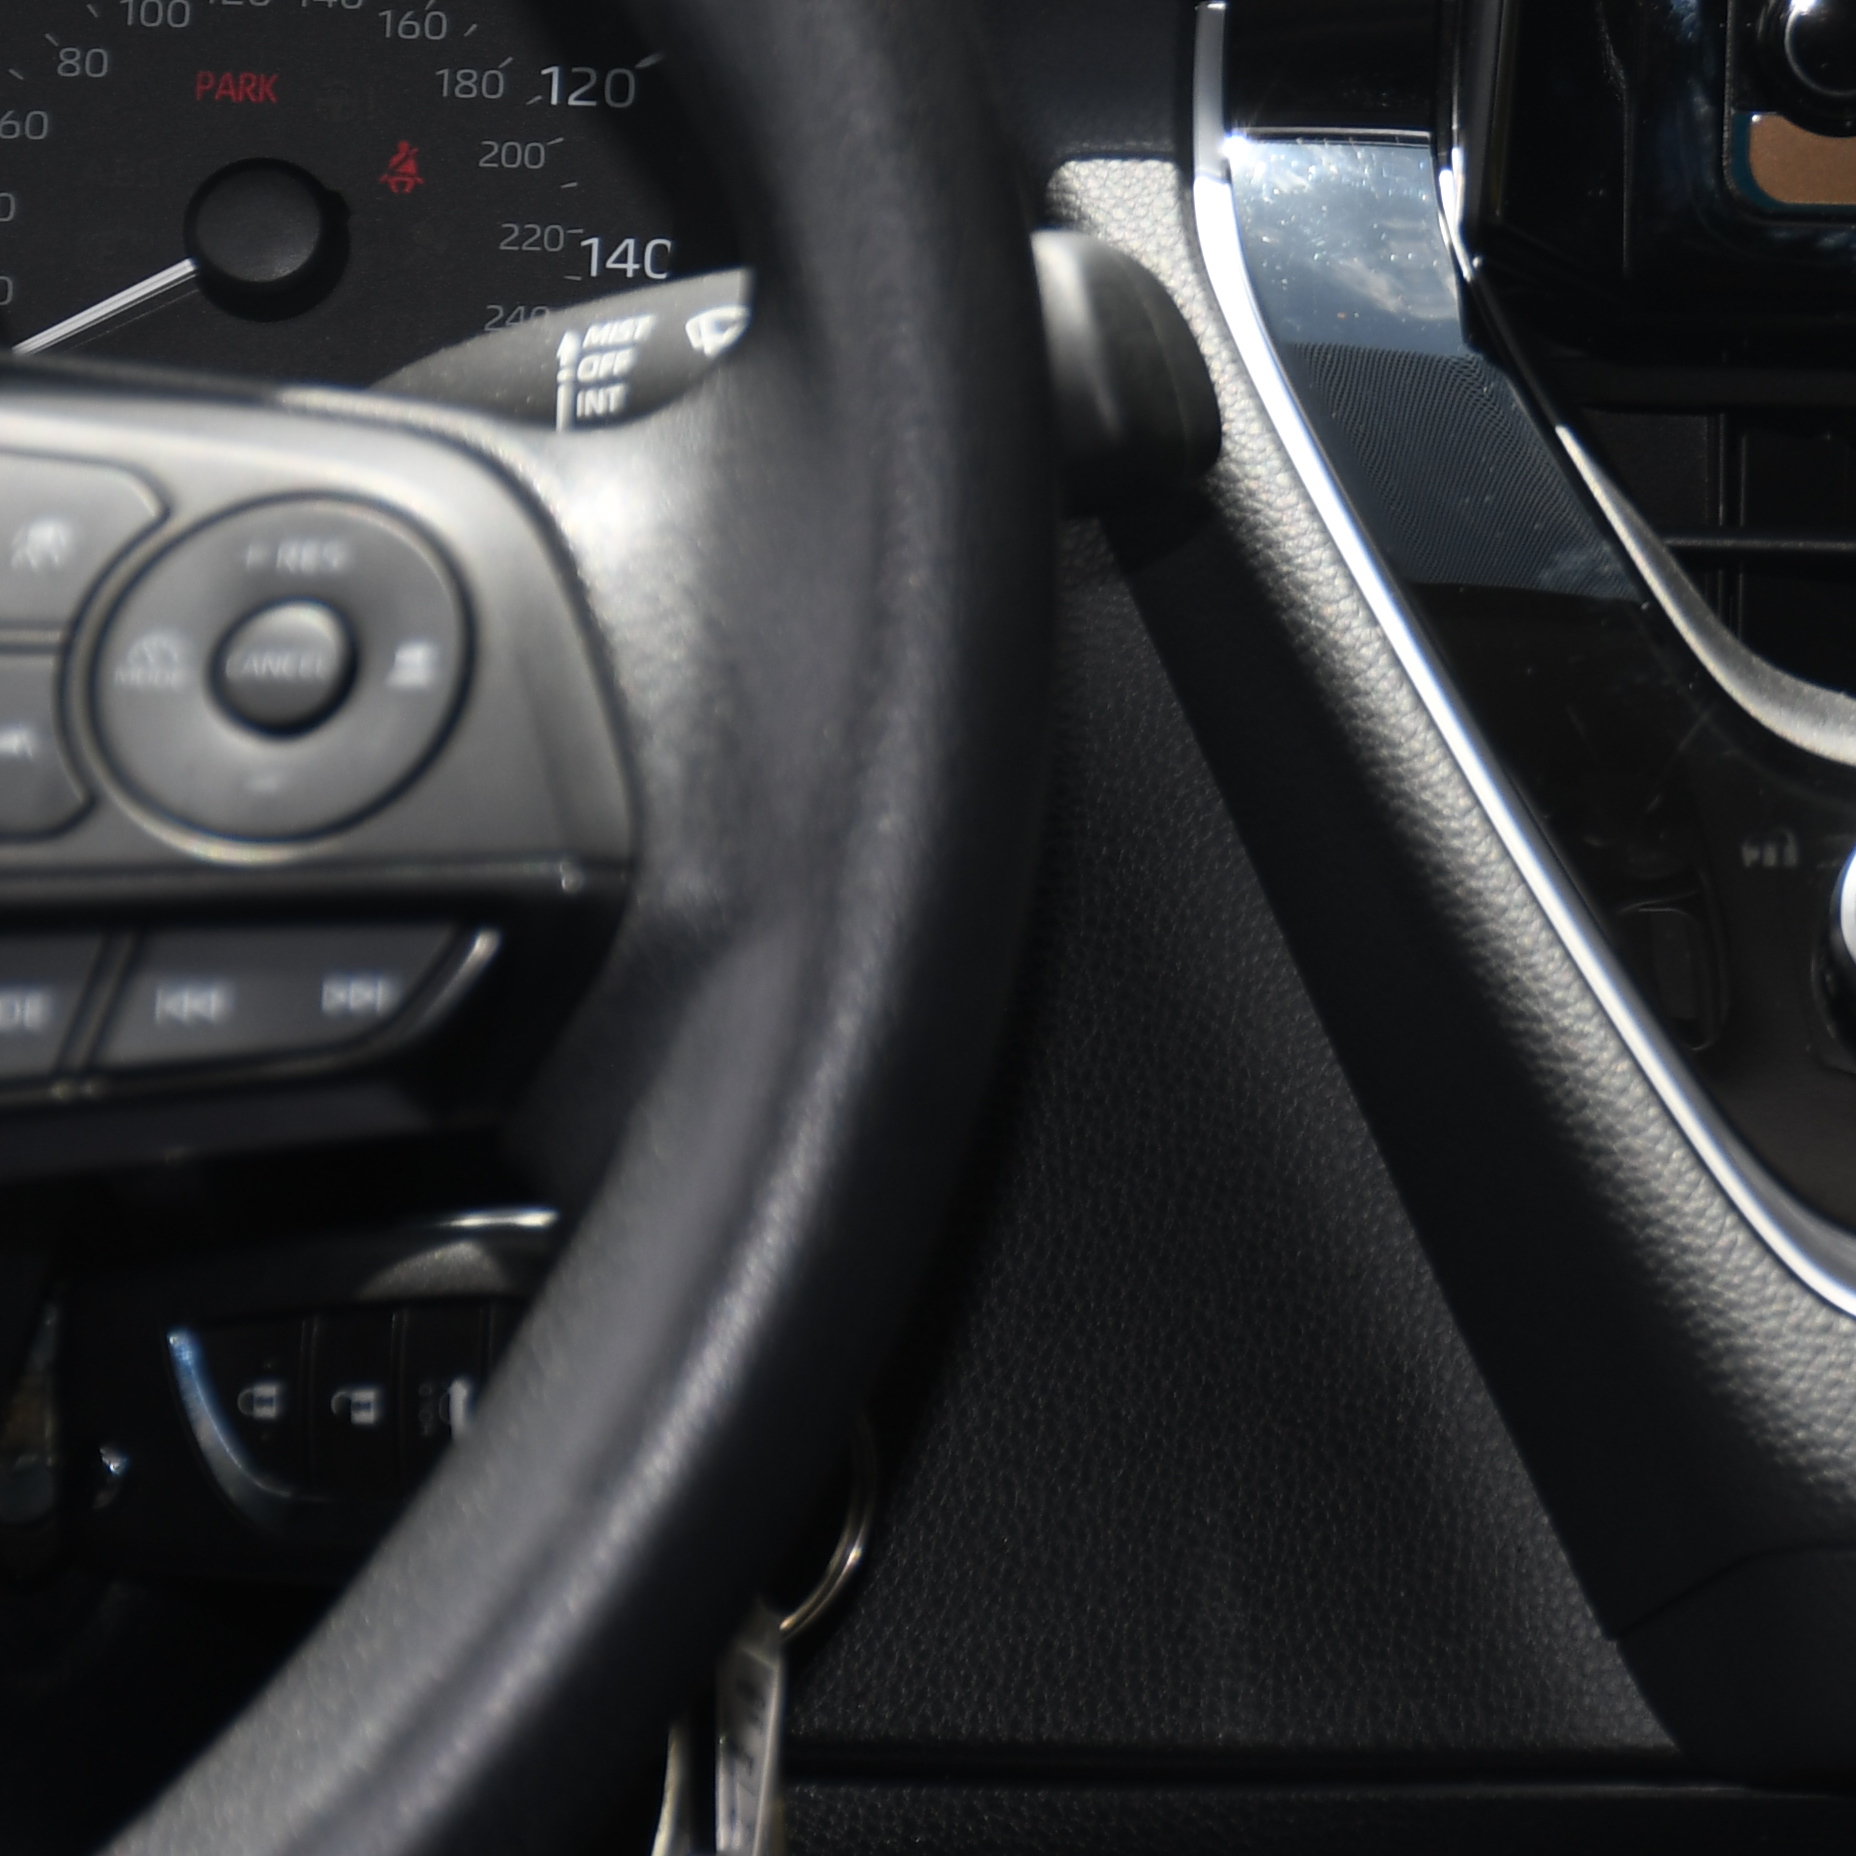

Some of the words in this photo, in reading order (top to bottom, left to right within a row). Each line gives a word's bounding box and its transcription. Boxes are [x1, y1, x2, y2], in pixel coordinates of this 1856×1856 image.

[378, 10, 448, 41] 160
[56, 47, 109, 79] 80
[196, 72, 279, 104] PARK
[436, 67, 505, 100] 180
[540, 65, 637, 108] 120
[0, 111, 49, 140] 60
[478, 140, 546, 170] 200
[499, 223, 565, 252] 220
[582, 313, 656, 348] MIST
[577, 348, 637, 383] OFF
[577, 383, 629, 418] INT
